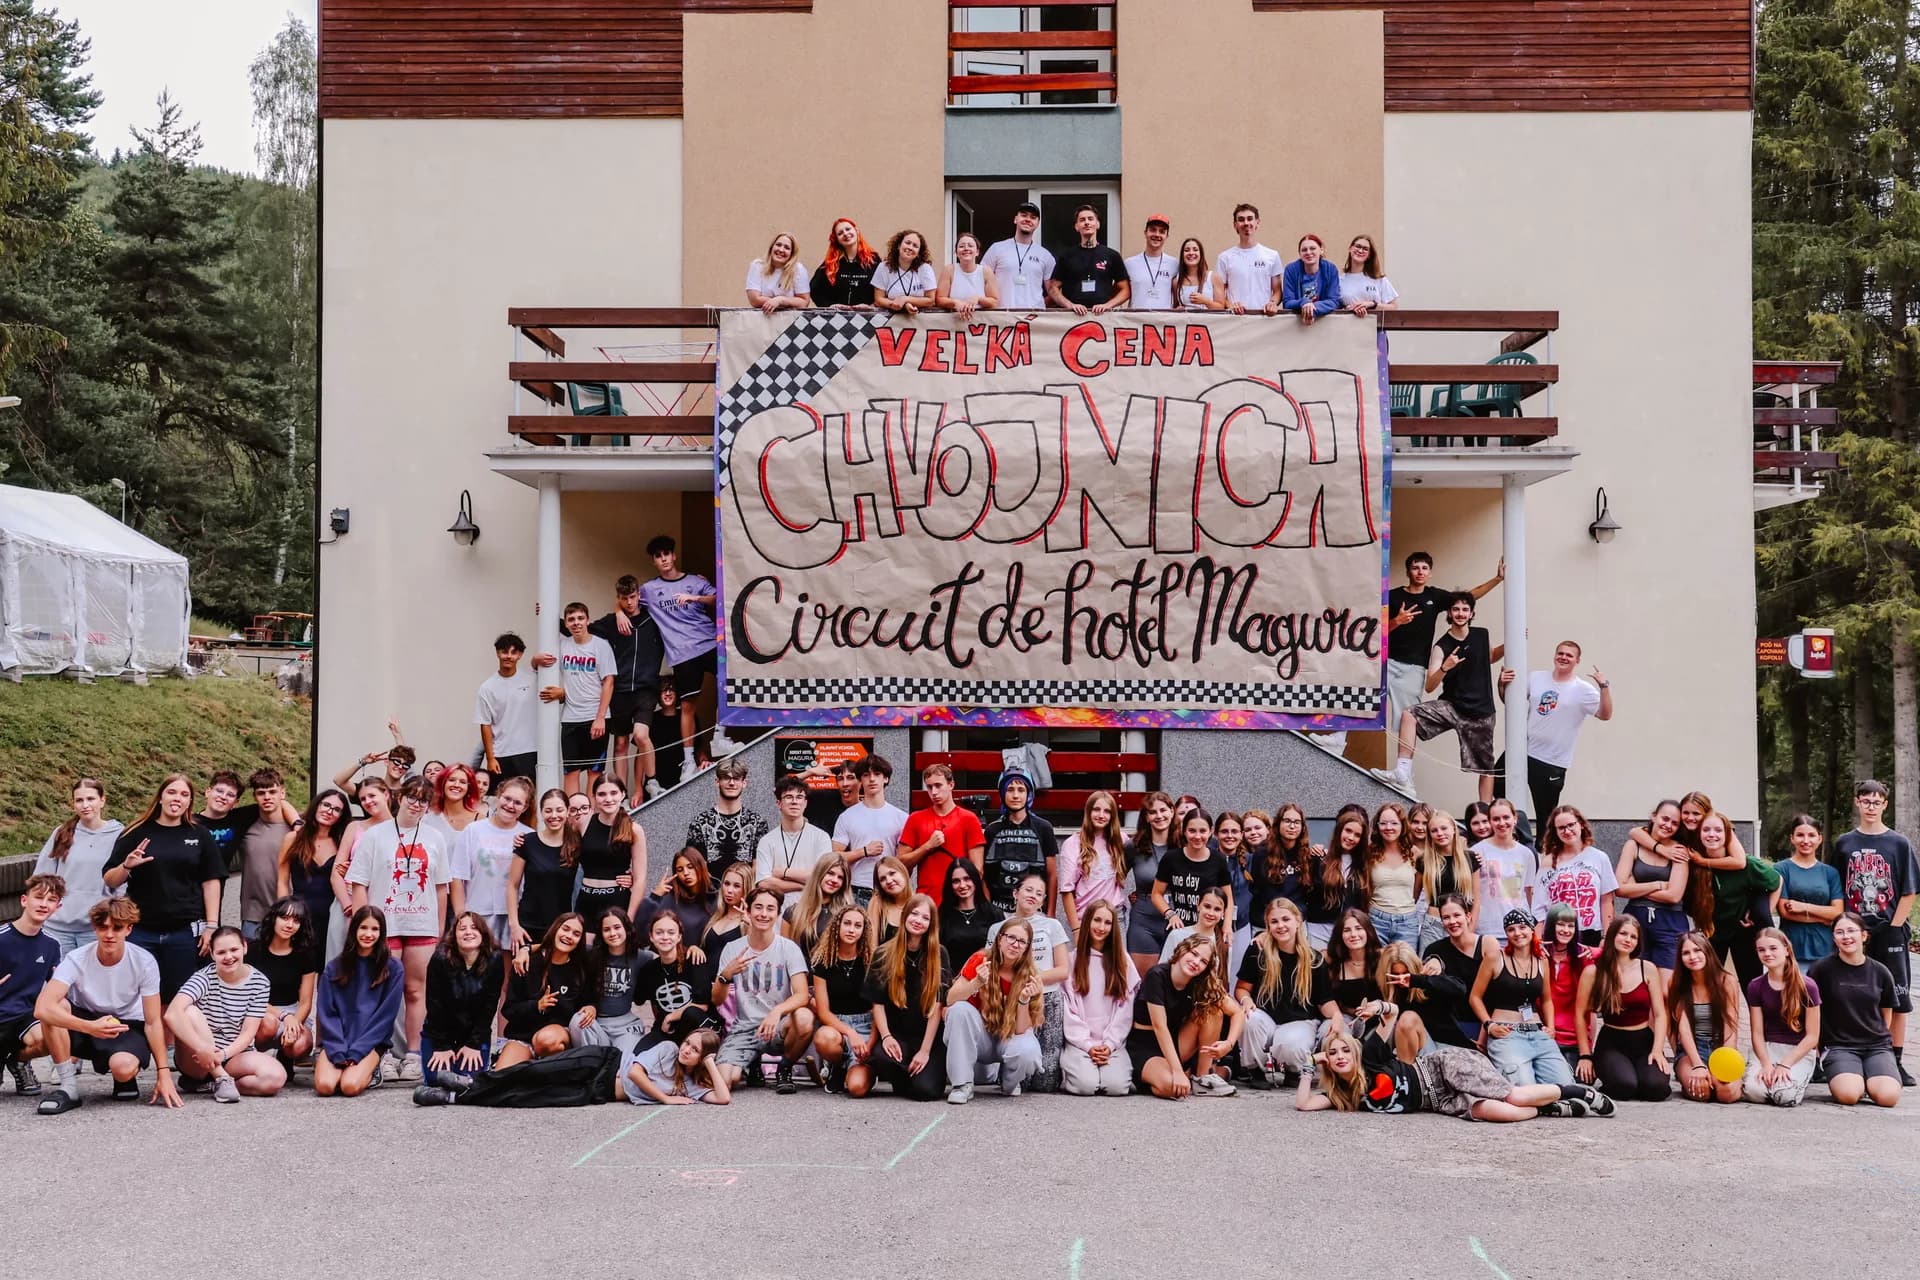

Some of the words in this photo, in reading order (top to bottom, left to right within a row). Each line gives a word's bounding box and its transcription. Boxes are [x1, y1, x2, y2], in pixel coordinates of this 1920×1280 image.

[1254, 260, 1266, 268] FIA
[1059, 320, 1215, 378] CENA
[730, 560, 985, 669] Circuit
[977, 560, 1053, 654] de
[1044, 558, 1186, 669] hotel
[1185, 555, 1380, 680] Magura
[592, 887, 616, 895] PRO
[1185, 872, 1200, 892] day
